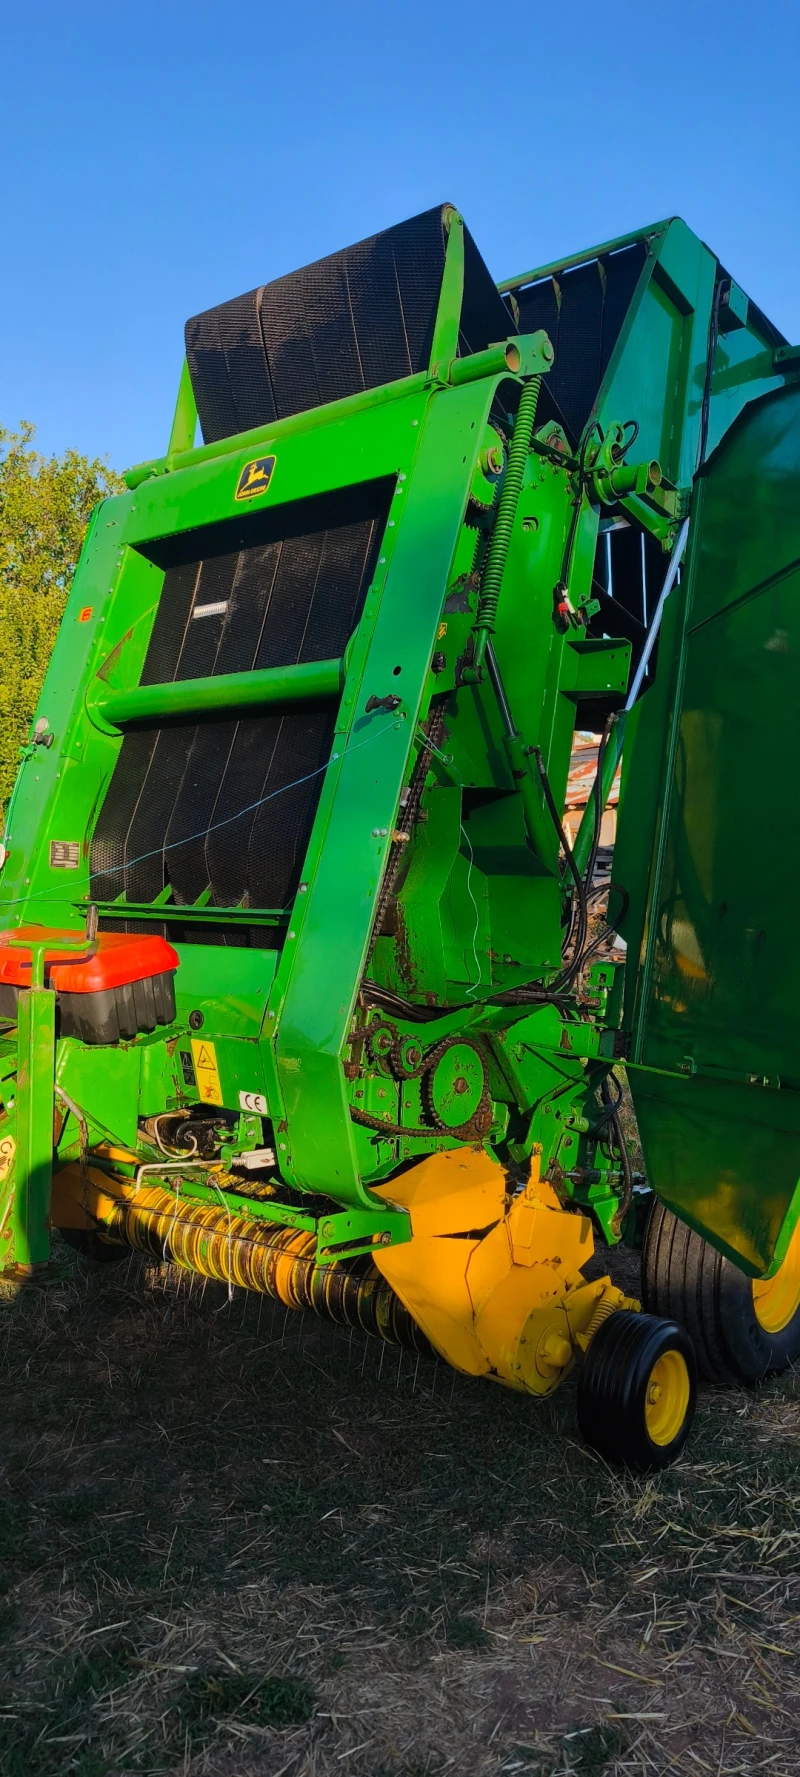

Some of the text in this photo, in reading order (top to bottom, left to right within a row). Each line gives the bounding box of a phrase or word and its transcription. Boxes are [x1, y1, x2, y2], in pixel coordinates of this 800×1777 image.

[238, 485, 266, 497] JOHN DEERE
[245, 1094, 262, 1112] CE
